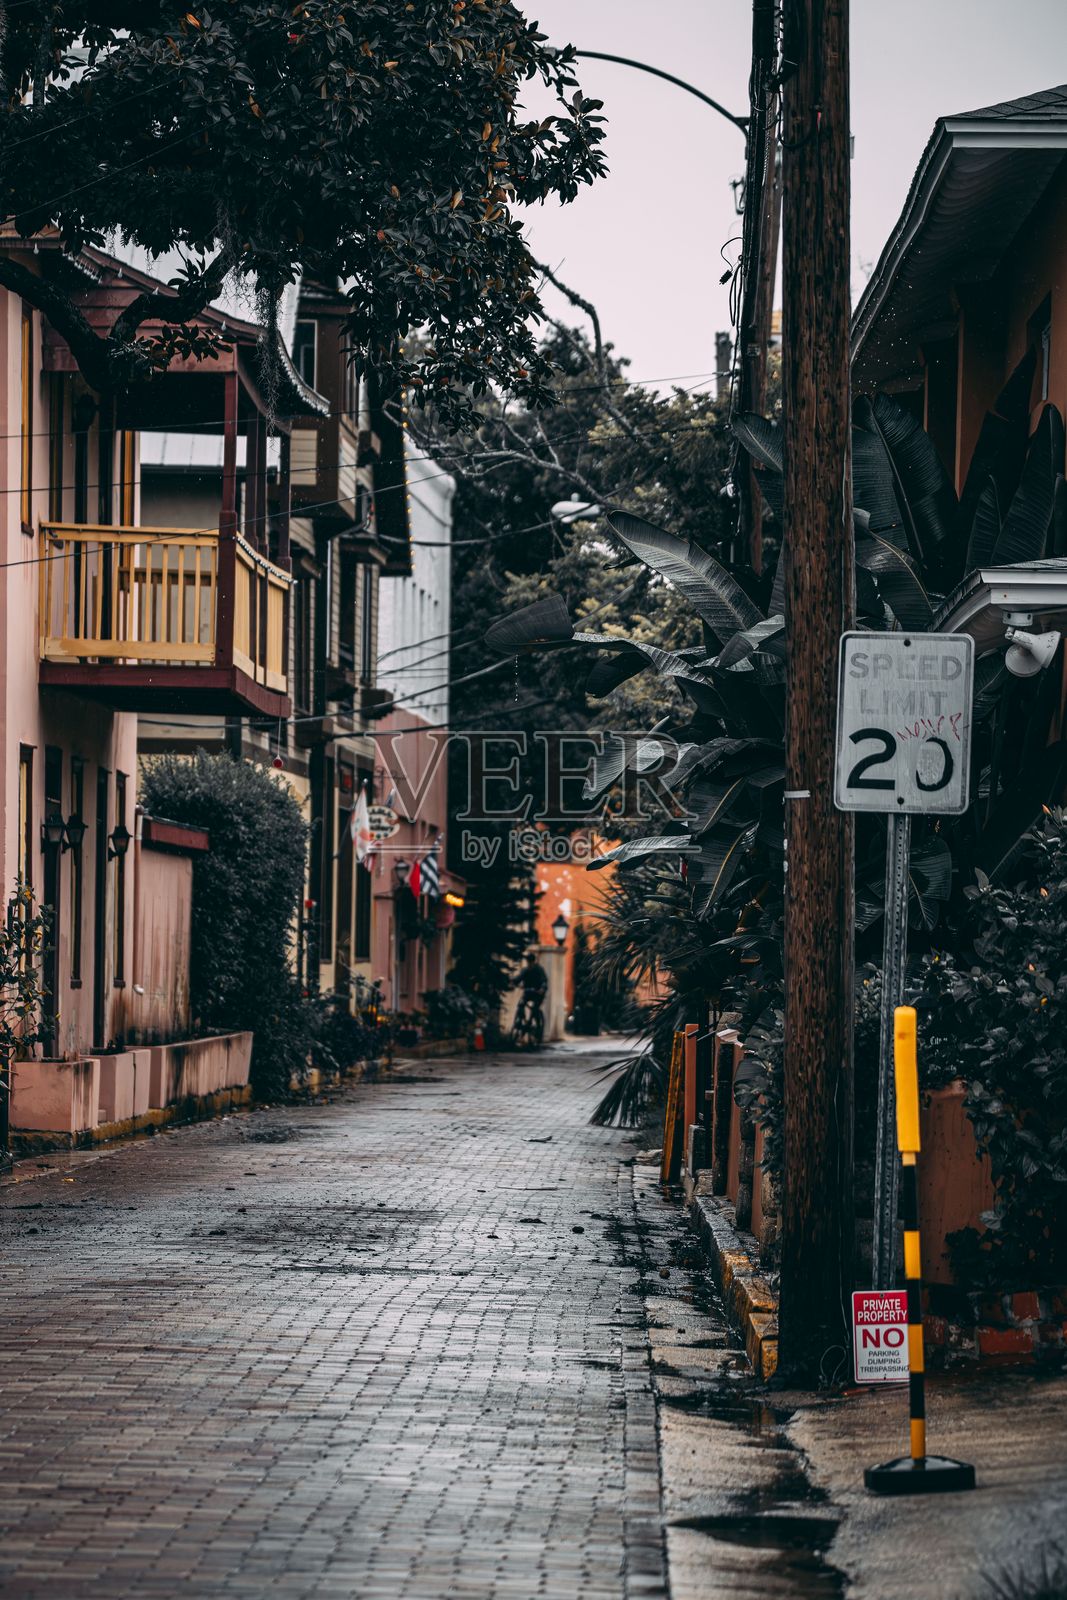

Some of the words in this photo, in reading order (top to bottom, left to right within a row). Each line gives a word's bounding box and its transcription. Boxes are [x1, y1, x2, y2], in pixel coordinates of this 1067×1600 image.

[849, 652, 962, 681] SPEED
[860, 688, 948, 716] LIMIT
[846, 727, 954, 792] 20
[857, 1310, 907, 1322] PROPERTY
[863, 1299, 901, 1311] PRIVATE
[862, 1327, 905, 1349] NO
